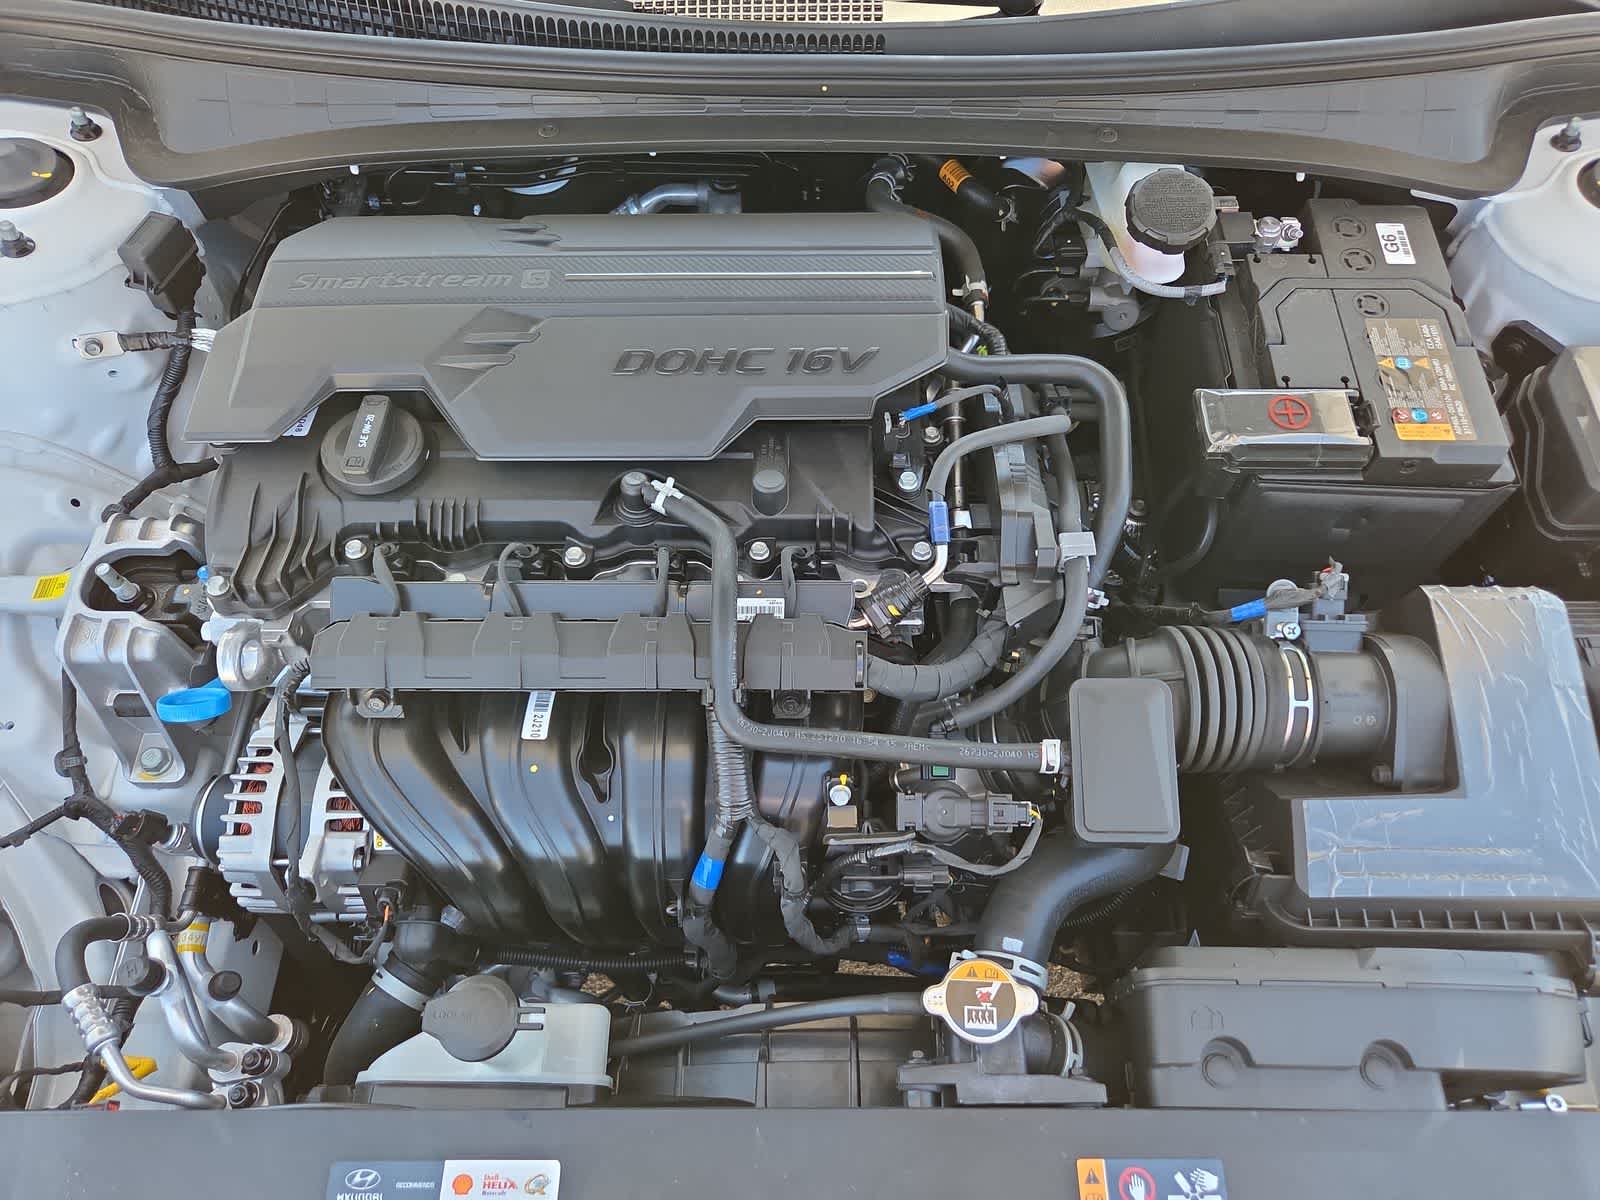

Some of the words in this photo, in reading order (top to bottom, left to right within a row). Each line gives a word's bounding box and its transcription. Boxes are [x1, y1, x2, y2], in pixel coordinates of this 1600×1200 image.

[1381, 234, 1400, 253] G6
[288, 271, 513, 290] Smartstream
[609, 345, 776, 376] DOHC
[785, 345, 881, 376] 16V
[361, 414, 376, 434] 0W-20
[358, 434, 369, 448] SAE
[530, 713, 544, 738] 2J210
[959, 746, 1023, 760] 26730-2J040
[482, 1180, 517, 1190] HELIX
[335, 1192, 384, 1200] HYUNDAI
